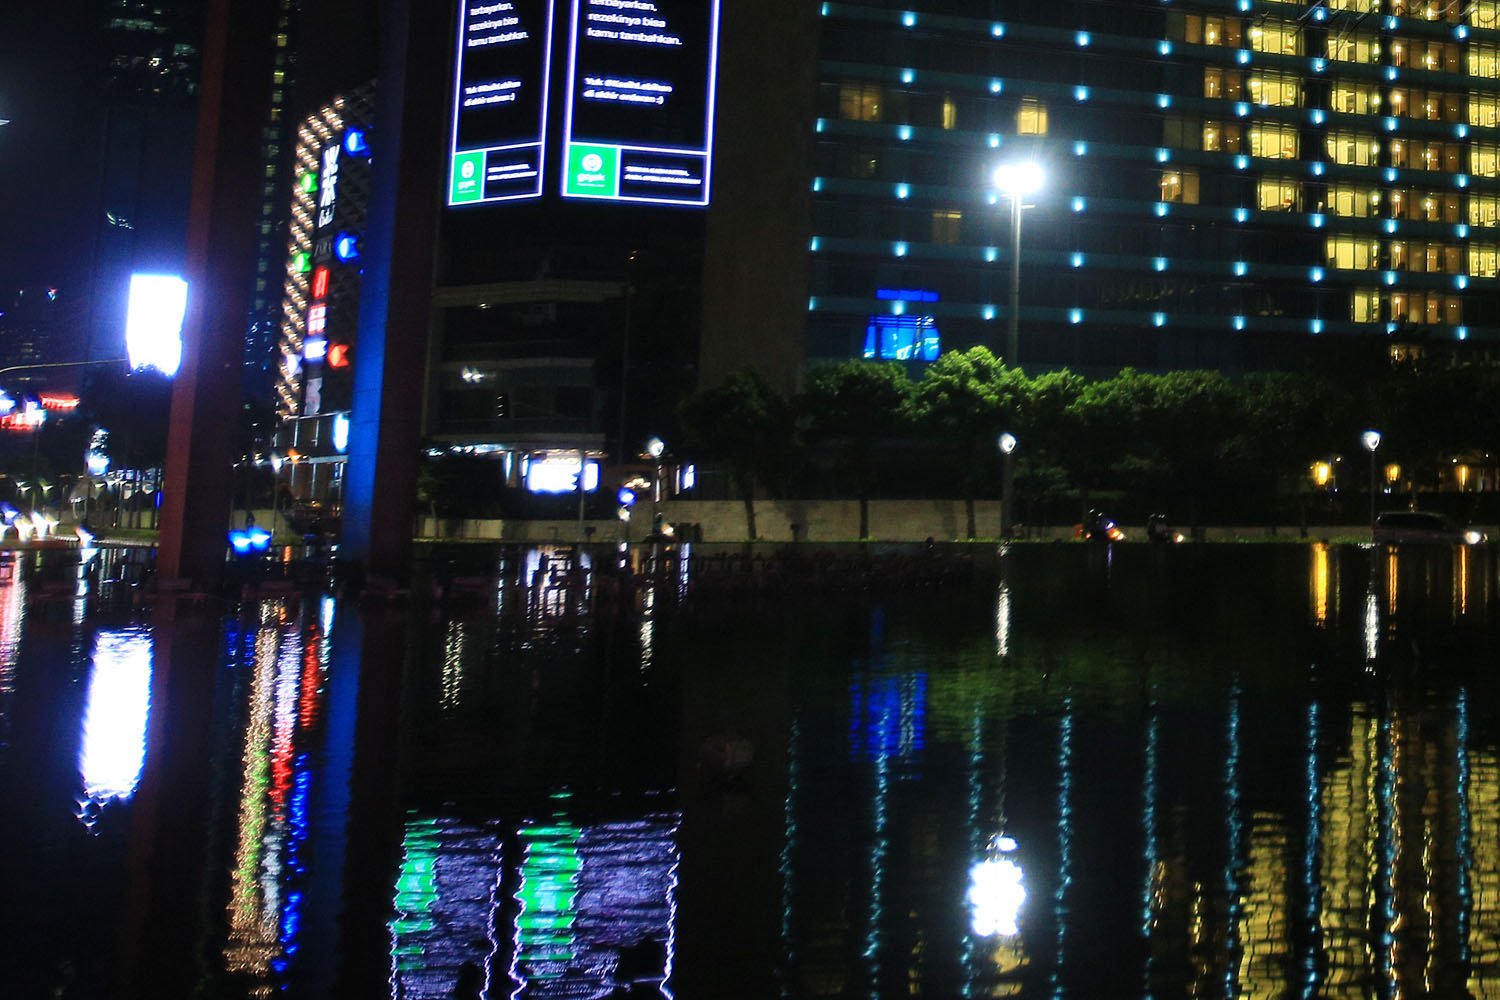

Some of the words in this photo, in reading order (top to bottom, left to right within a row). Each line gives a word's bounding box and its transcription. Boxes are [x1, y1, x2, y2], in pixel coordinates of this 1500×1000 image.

[588, 13, 641, 26] rezekinya
[642, 17, 666, 27] bisa
[587, 27, 618, 38] kamu
